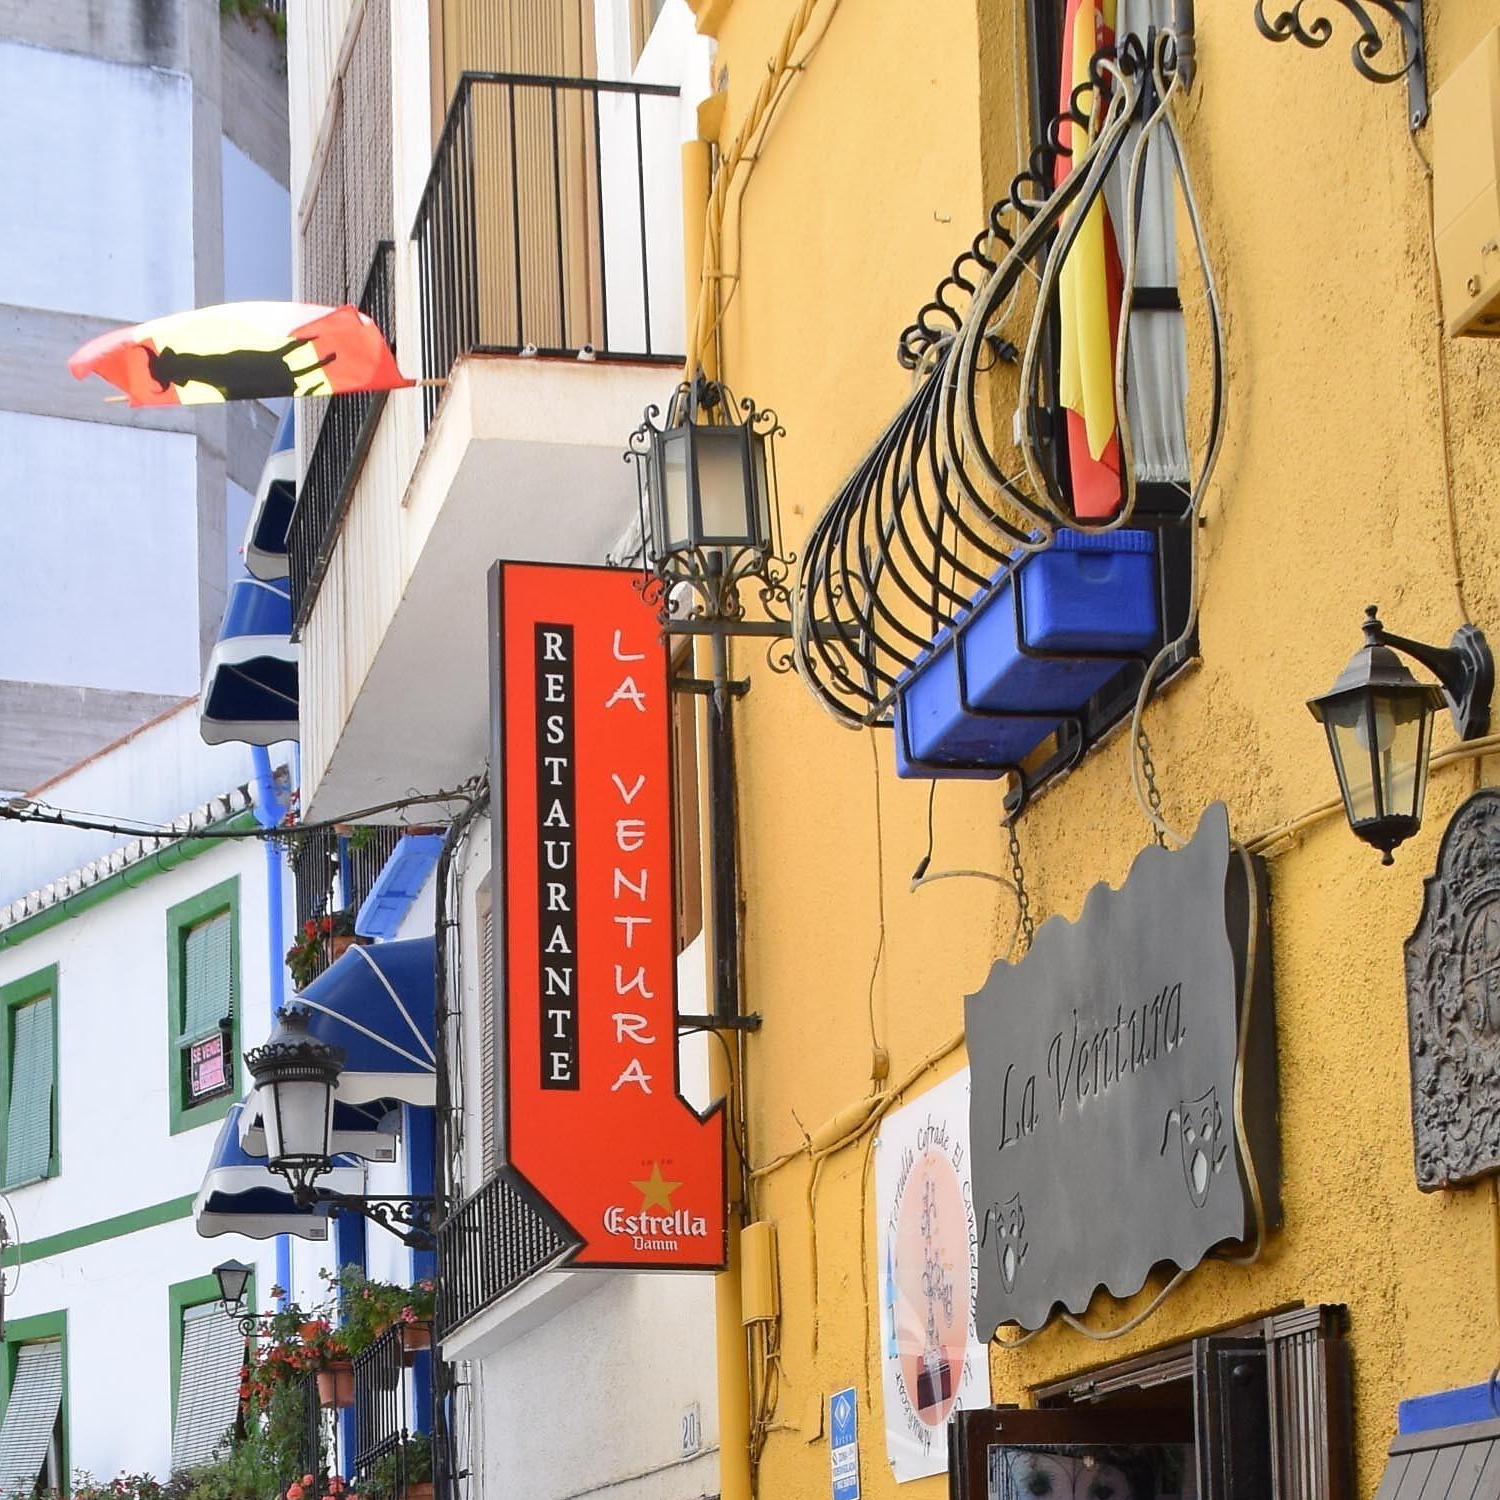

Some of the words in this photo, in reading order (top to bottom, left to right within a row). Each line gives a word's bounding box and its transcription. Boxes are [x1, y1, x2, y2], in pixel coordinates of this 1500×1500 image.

[605, 630, 647, 711] LA
[543, 630, 571, 1083] RESTAURANTE
[610, 773, 656, 1096] VENTURA
[998, 1063, 1039, 1151] La
[1047, 982, 1186, 1116] Ventura
[917, 1113, 949, 1157] Cofrade
[603, 1205, 708, 1236] Estrella
[632, 1235, 678, 1251] Damm
[682, 1412, 695, 1449] 20
